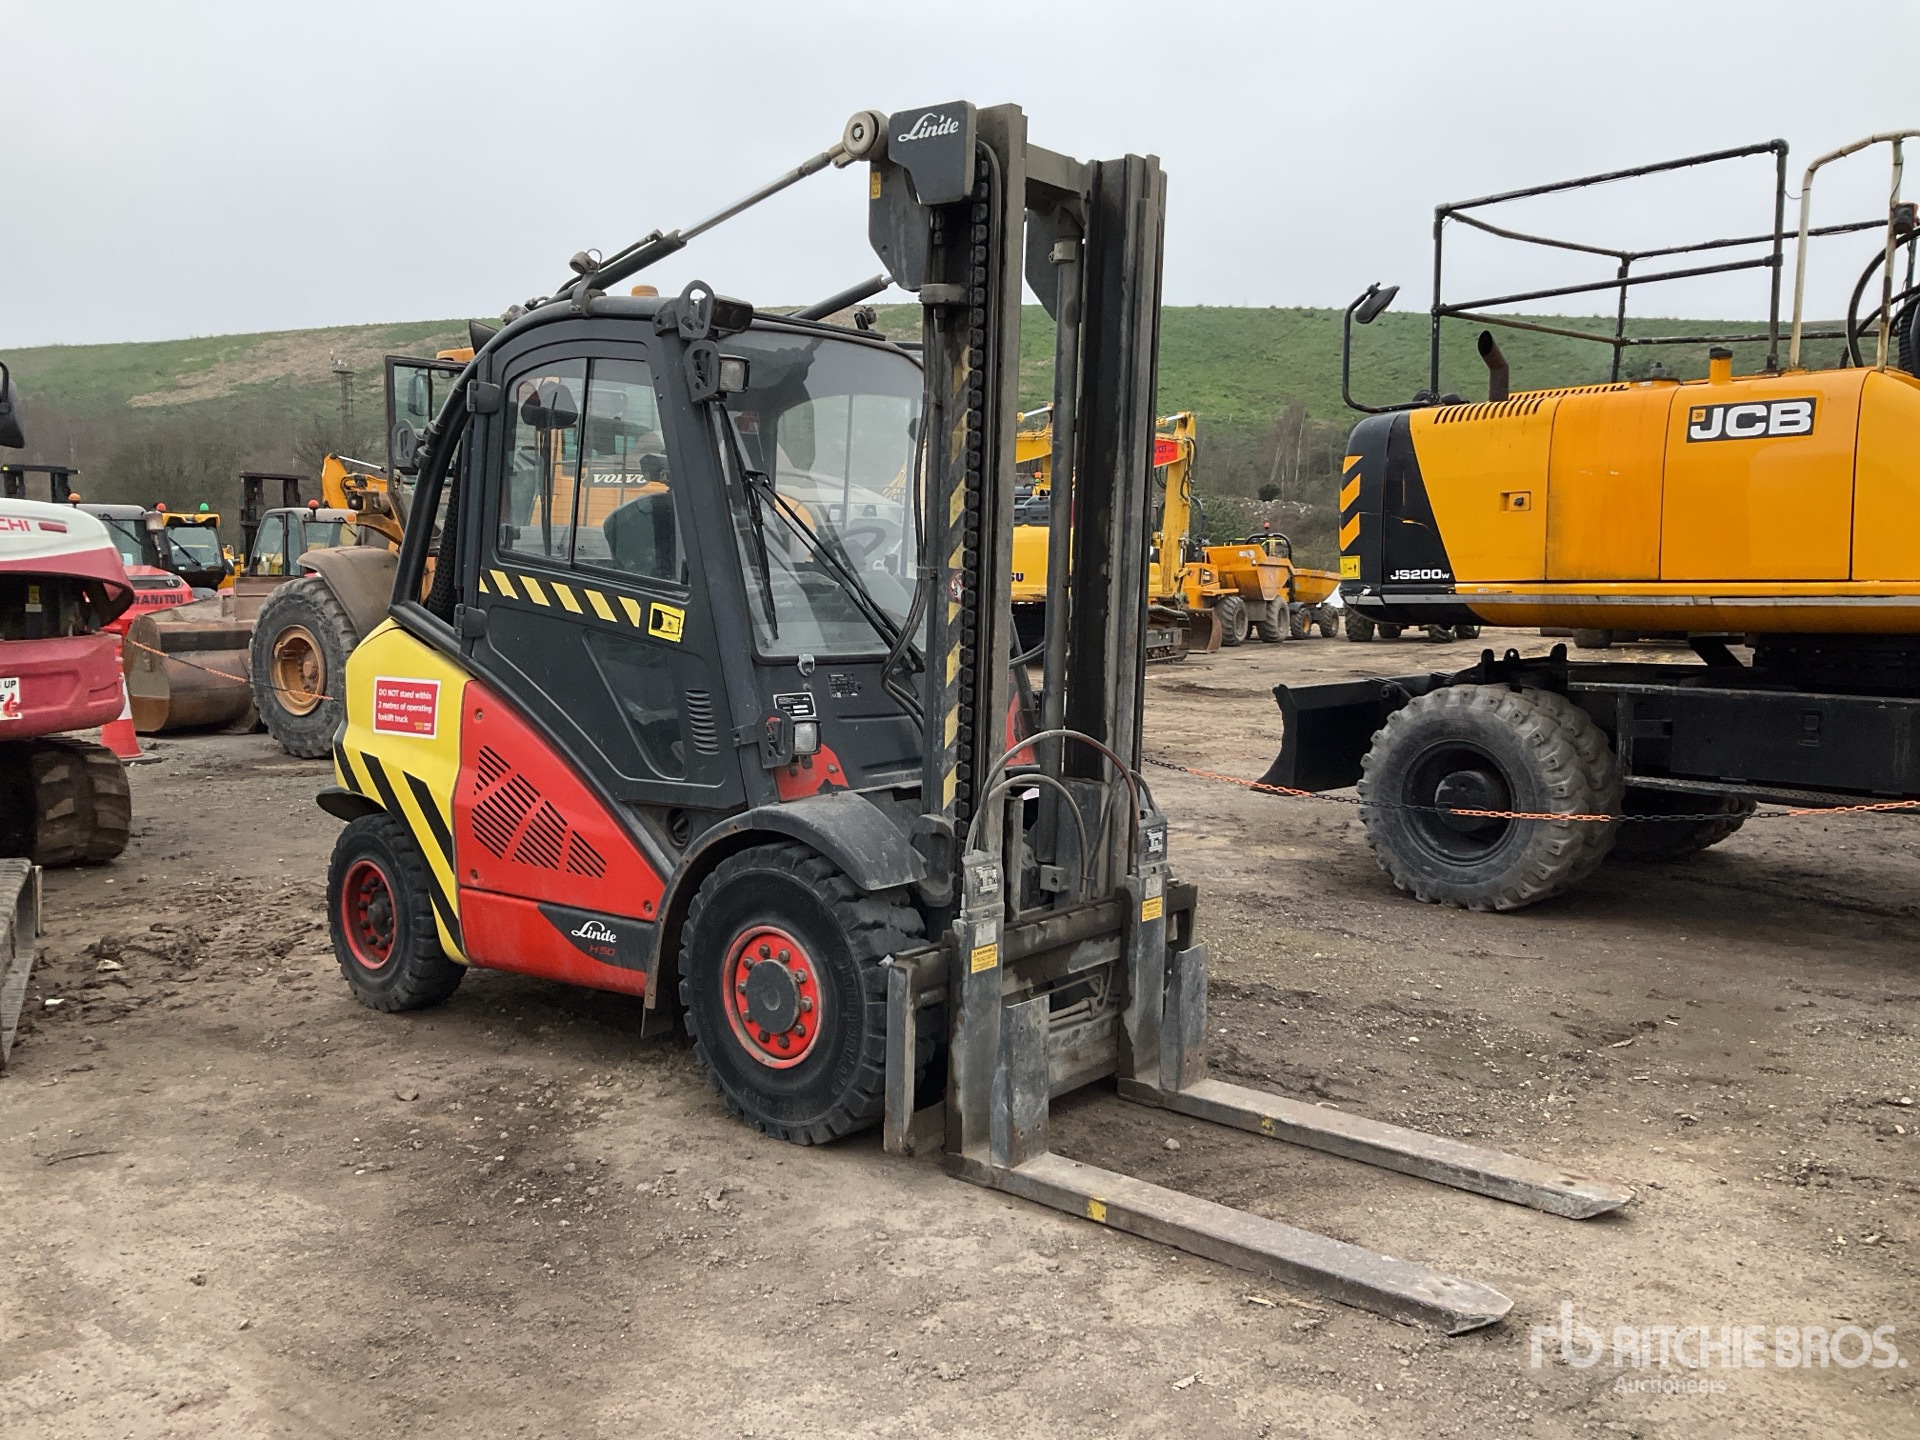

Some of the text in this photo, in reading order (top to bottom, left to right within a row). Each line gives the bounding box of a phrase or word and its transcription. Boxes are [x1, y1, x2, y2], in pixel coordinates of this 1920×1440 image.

[898, 112, 959, 142] Linde
[1690, 401, 1812, 440] JCB
[4, 680, 16, 689] UP
[378, 688, 432, 700] DO NOT stand within
[378, 700, 432, 714] 2 metres of operating
[378, 713, 408, 723] forklift truck
[570, 920, 617, 943] Linde
